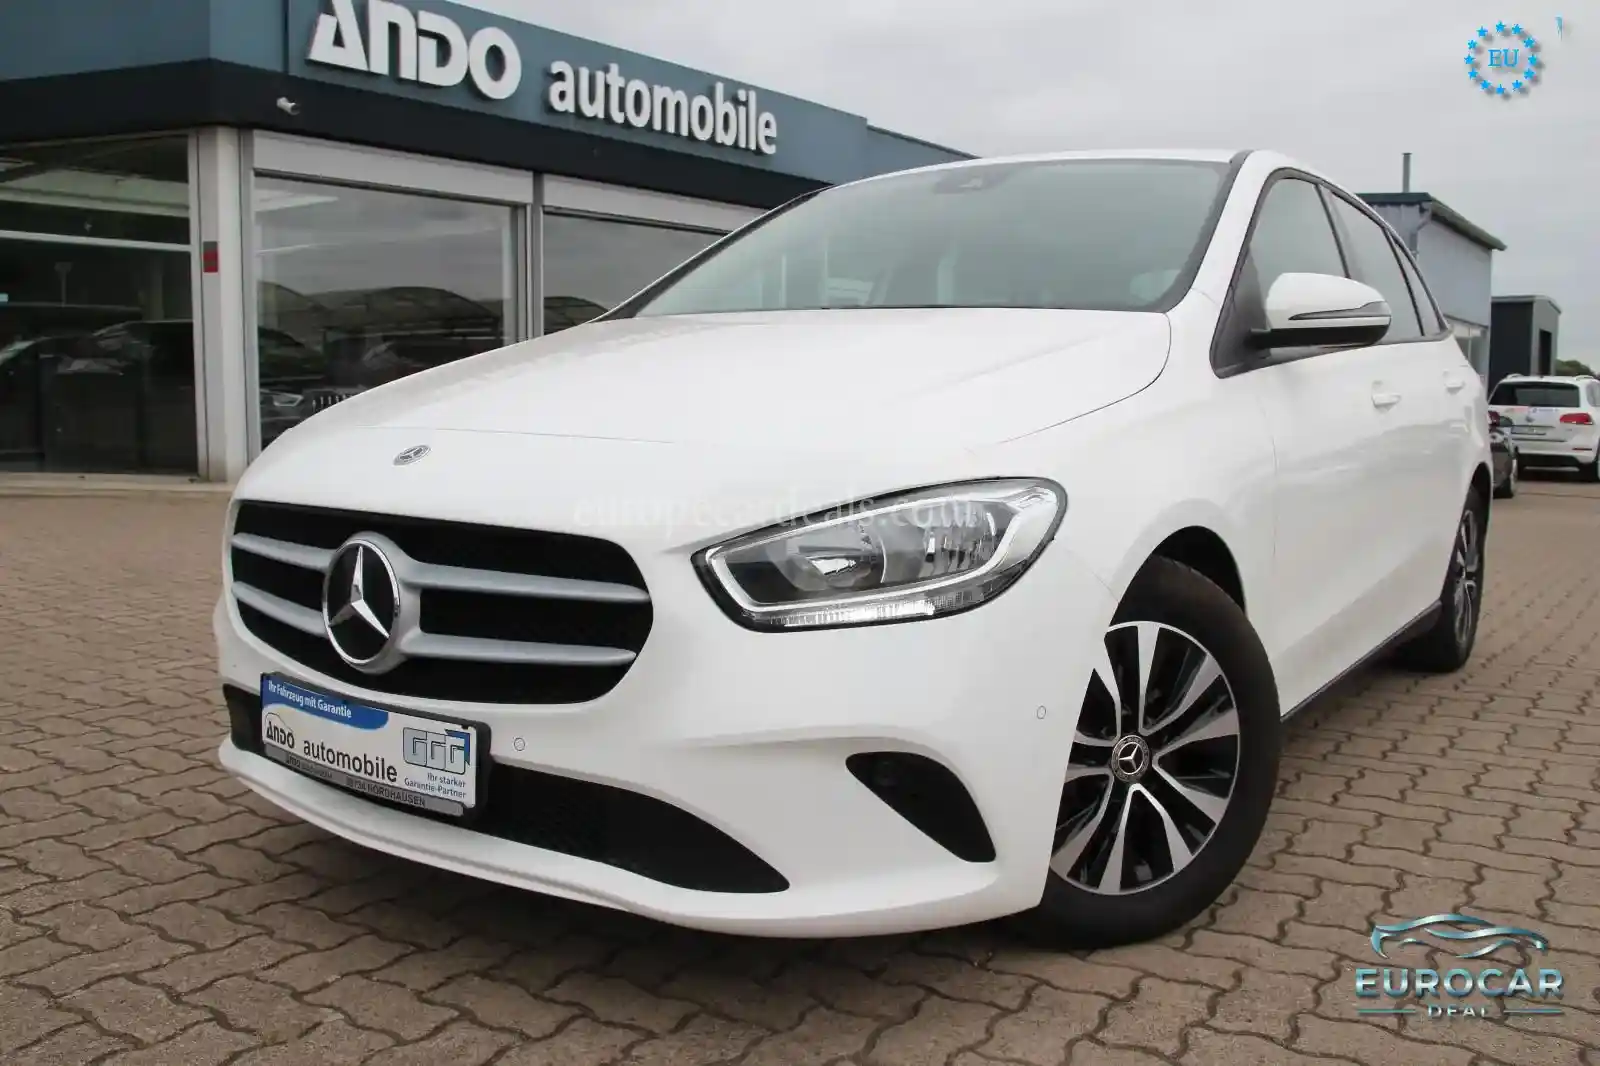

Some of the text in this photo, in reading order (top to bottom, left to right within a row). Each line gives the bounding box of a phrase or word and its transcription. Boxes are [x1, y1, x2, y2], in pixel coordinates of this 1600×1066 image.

[306, 0, 777, 155] ANDO automobile
[268, 680, 352, 718] Ihr Fahrzeug mit Garantie
[266, 720, 295, 749] ANDO
[303, 738, 398, 782] automobile
[367, 783, 426, 806] NORDHAUSEN
[404, 777, 467, 798] Garantie-Partner
[428, 772, 466, 788] Ihr starker
